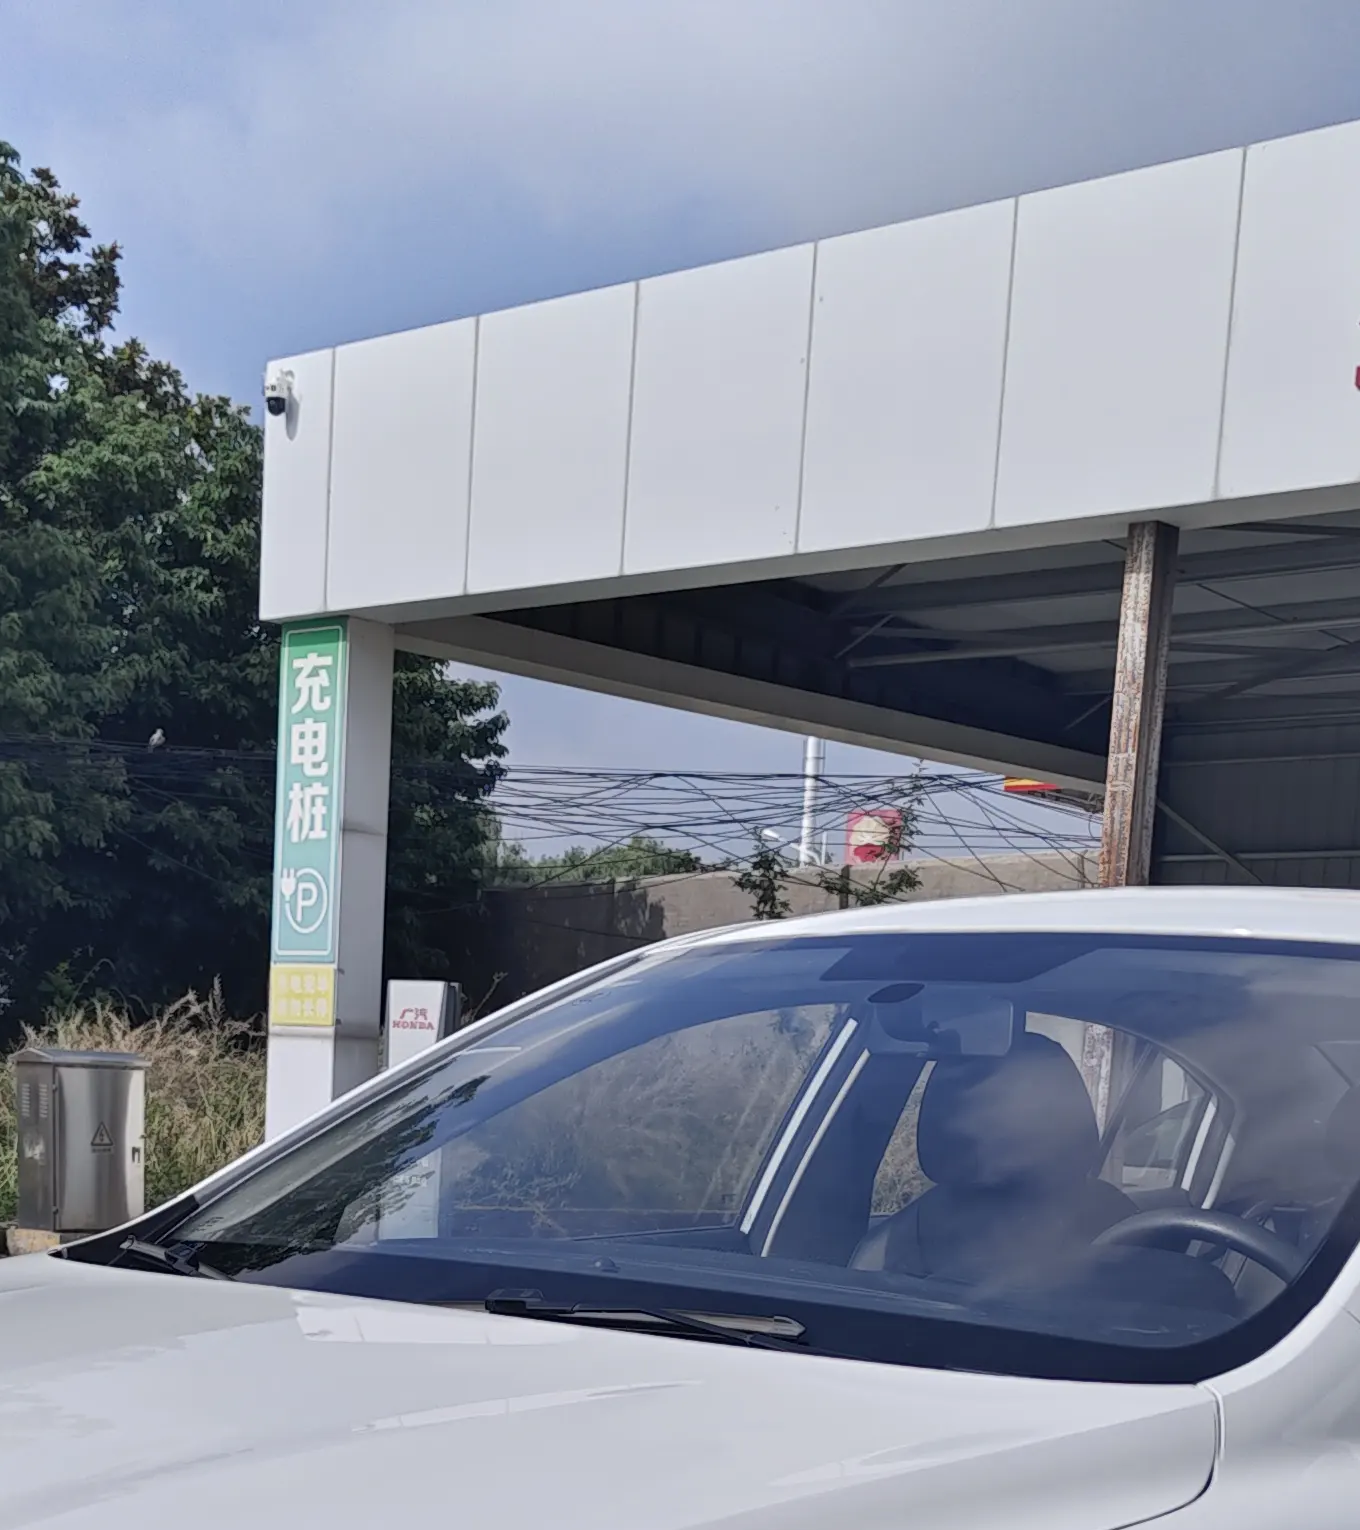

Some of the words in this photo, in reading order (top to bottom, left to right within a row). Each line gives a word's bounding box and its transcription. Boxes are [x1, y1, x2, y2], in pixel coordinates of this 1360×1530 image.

[287, 653, 333, 843] 充电桩
[392, 1020, 435, 1031] HONDA
